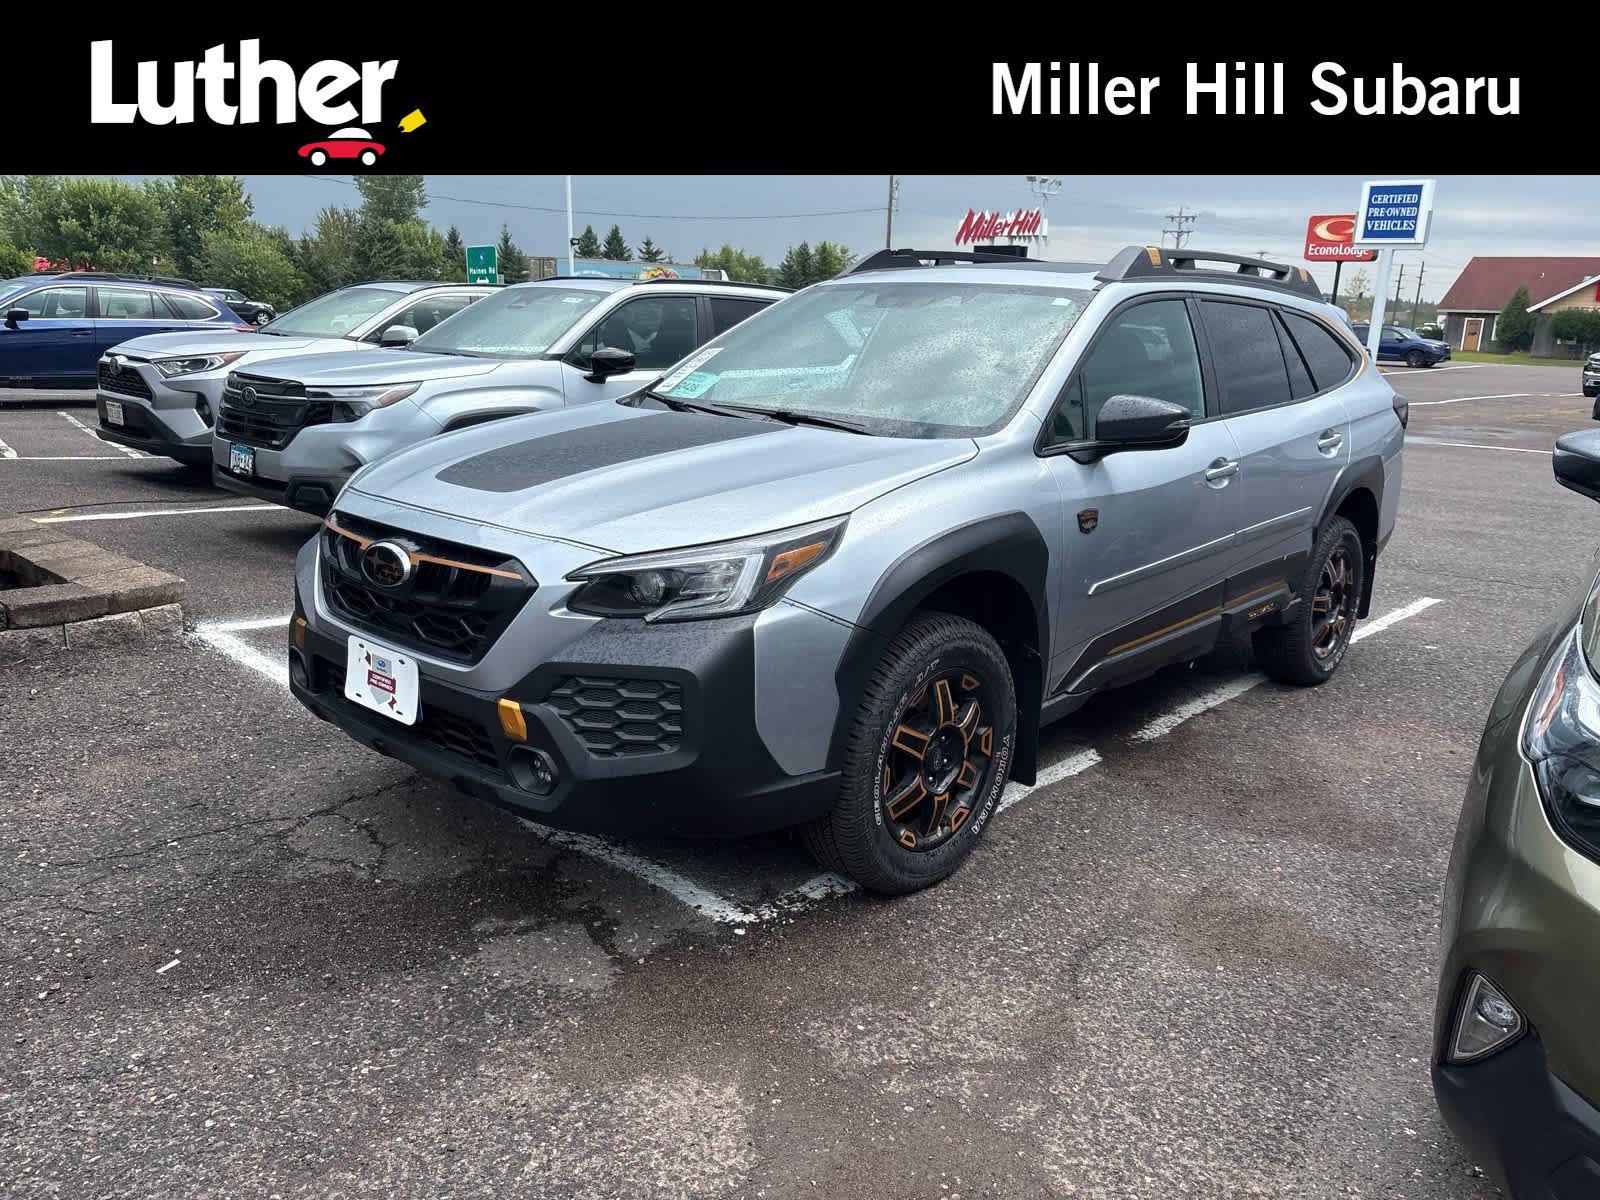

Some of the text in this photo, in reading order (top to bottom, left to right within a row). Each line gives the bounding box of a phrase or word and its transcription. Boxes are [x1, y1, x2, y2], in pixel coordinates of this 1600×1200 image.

[1371, 194, 1418, 204] CERTIFIED
[1367, 220, 1416, 231] VEHICLES
[971, 734, 1010, 835] YOKOHAMA
